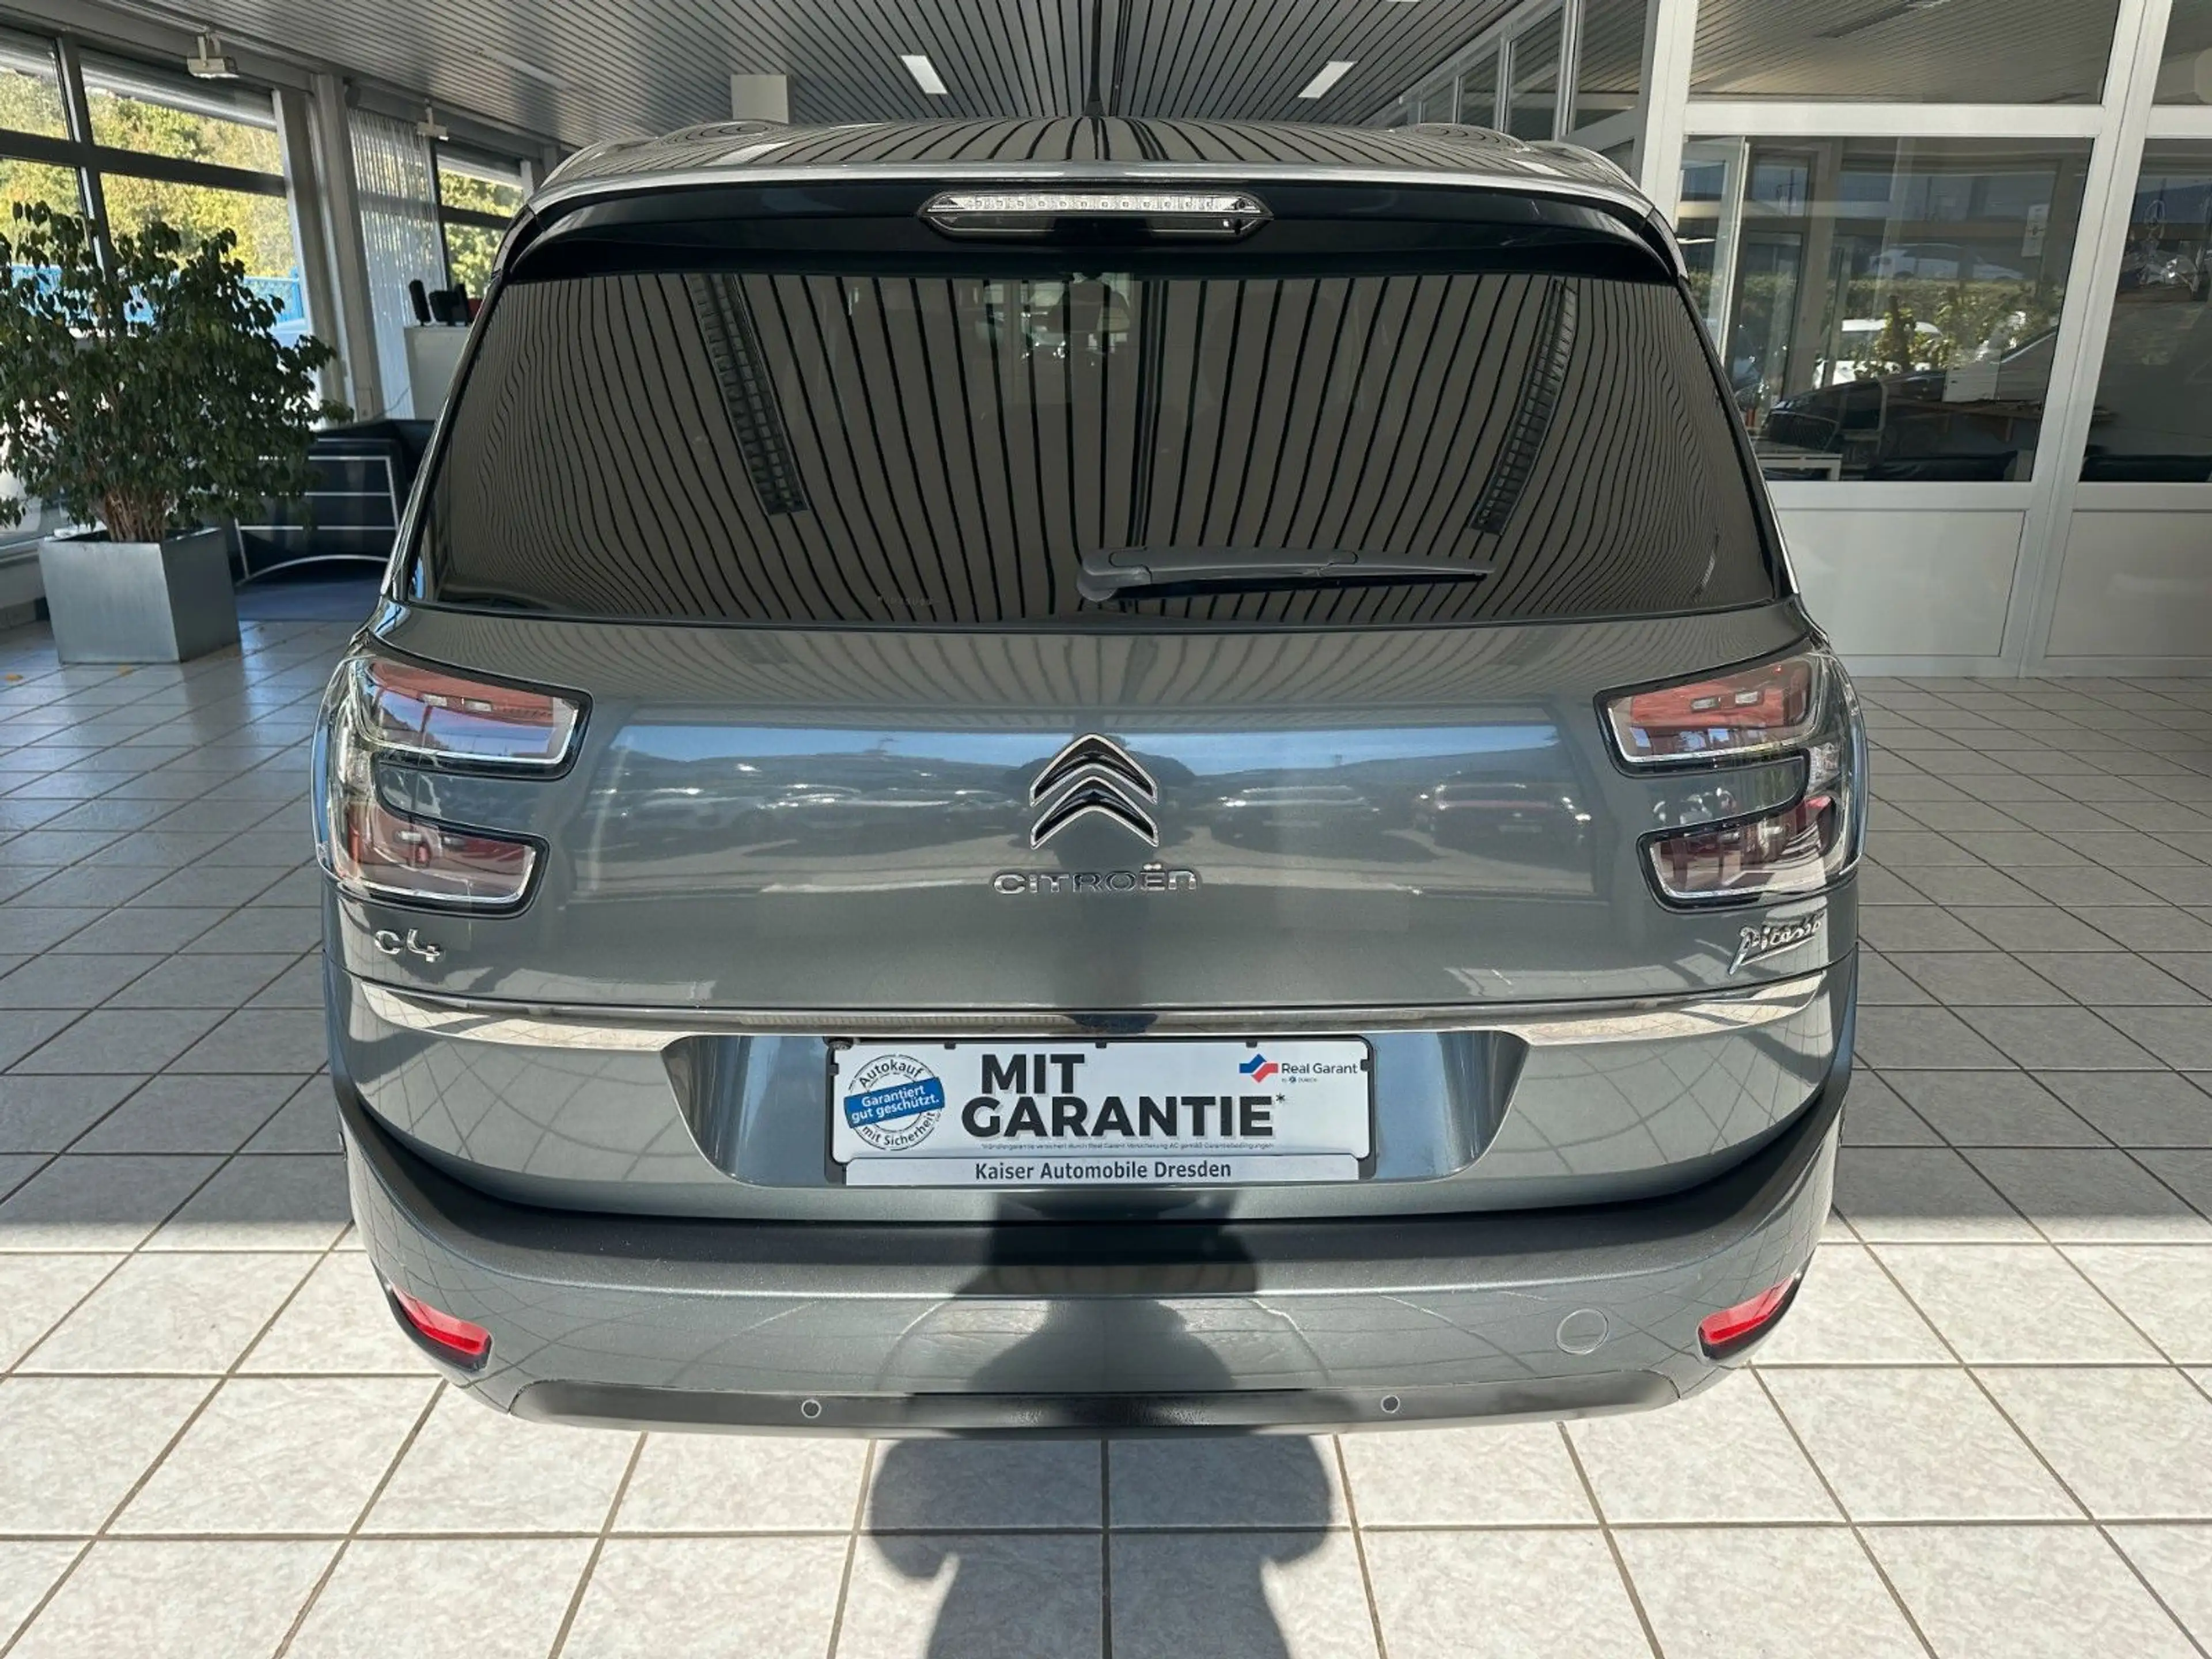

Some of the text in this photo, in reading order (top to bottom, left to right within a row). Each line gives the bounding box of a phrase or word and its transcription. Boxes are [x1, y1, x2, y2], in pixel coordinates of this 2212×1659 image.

[993, 863, 1198, 895] CITROËN
[374, 928, 440, 963] C4
[859, 1059, 925, 1088] Autokauf
[982, 1054, 1085, 1094] MIT
[1282, 1063, 1358, 1074] Real Garant
[851, 1093, 940, 1123] gut geschützt.
[861, 1085, 926, 1107] Garantiert
[863, 1112, 935, 1146] mit Sicherheit
[975, 1160, 1231, 1180] Kaiser Automobile Dresden
